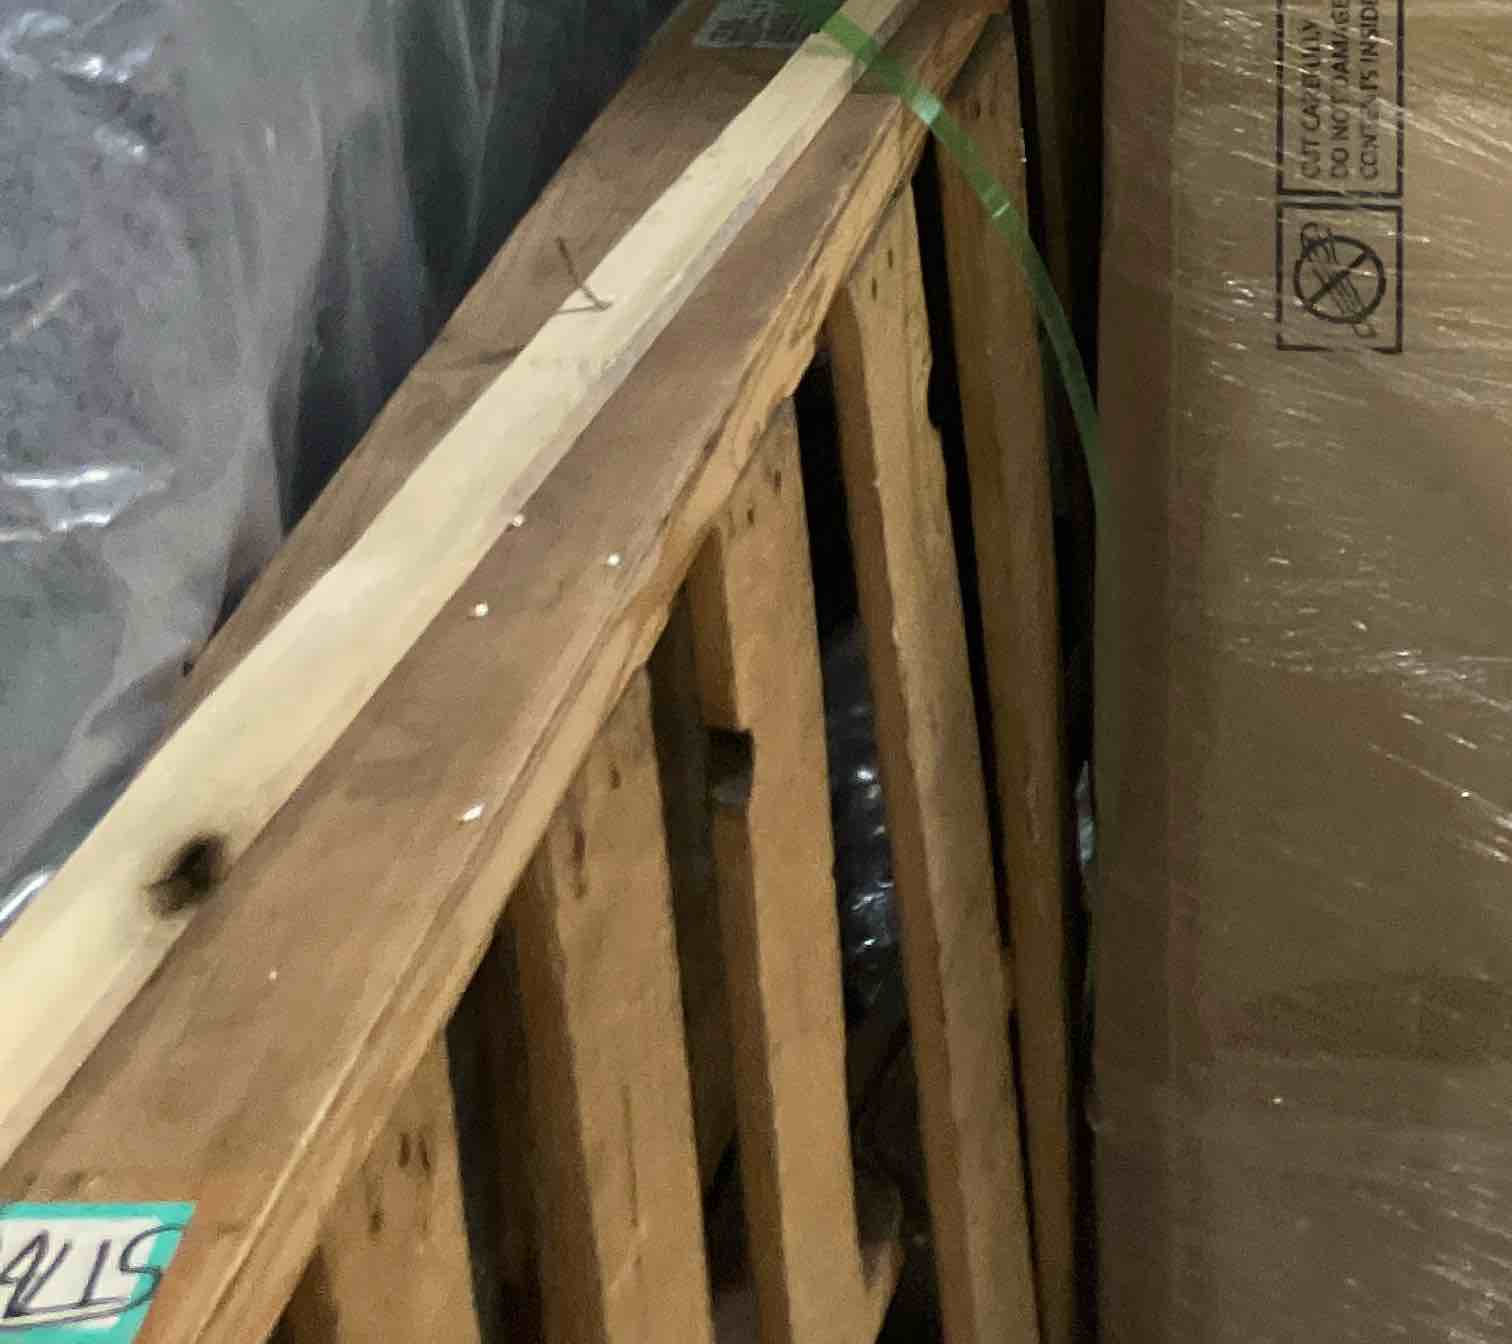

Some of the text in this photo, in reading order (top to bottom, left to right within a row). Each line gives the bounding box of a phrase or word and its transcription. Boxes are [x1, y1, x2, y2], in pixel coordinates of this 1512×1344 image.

[1330, 96, 1350, 142] NOT
[1358, 69, 1380, 181] CONTENTS
[1302, 138, 1322, 180] CUT
[1330, 146, 1350, 180] DO
